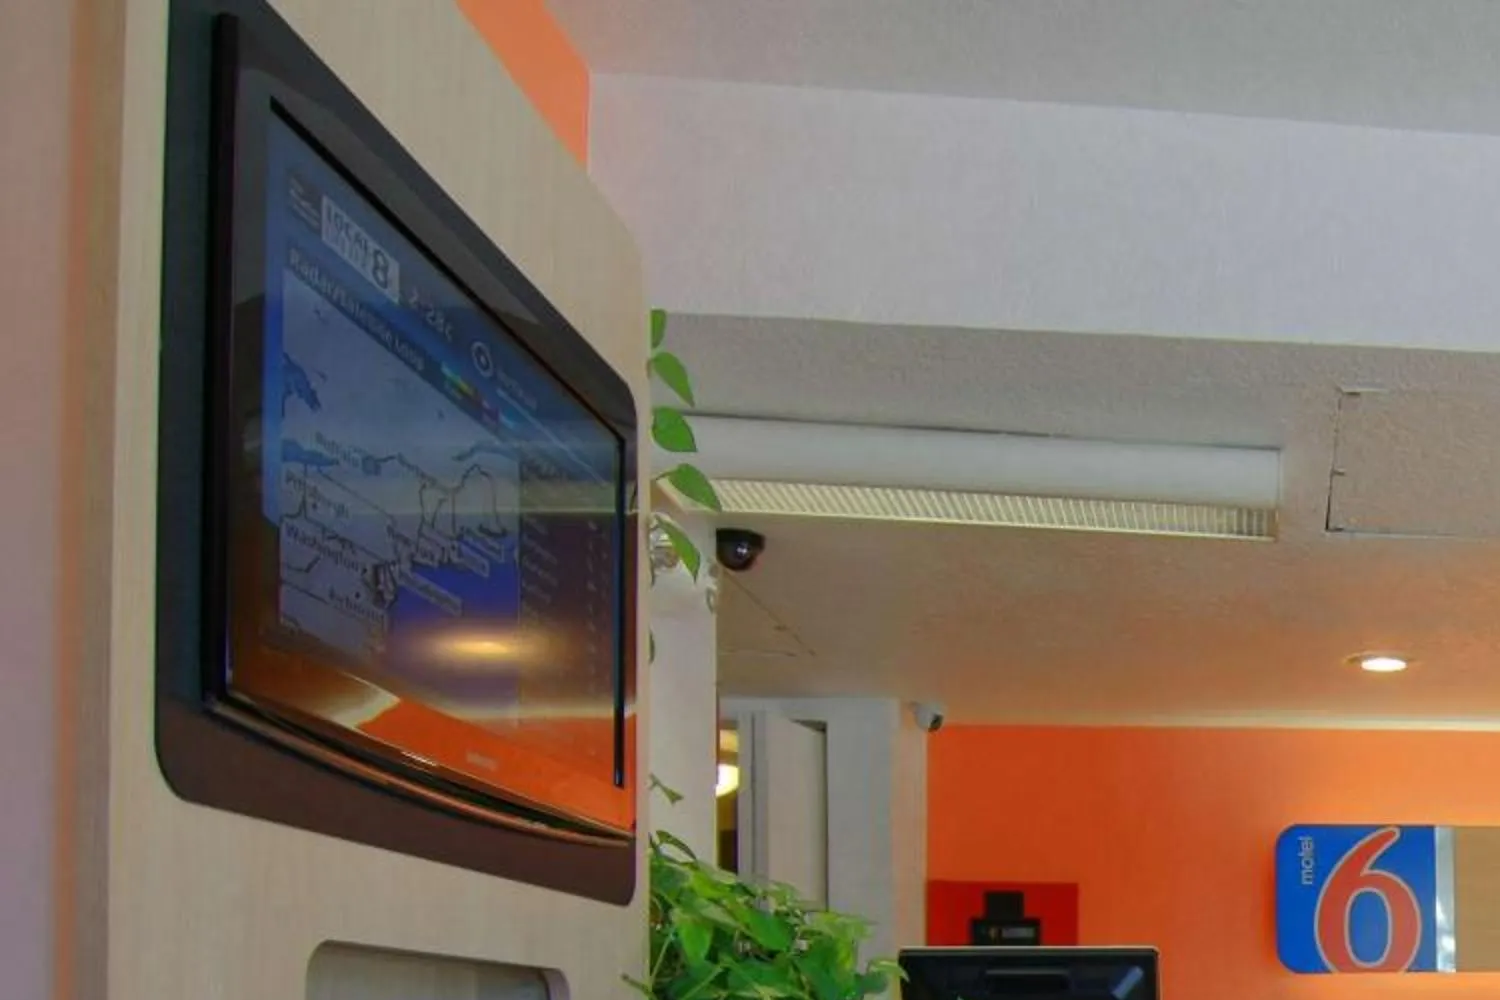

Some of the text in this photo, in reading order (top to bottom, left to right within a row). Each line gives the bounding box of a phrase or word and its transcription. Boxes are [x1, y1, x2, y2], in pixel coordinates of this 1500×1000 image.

[371, 242, 390, 294] 8
[1298, 826, 1422, 973] motel 6
